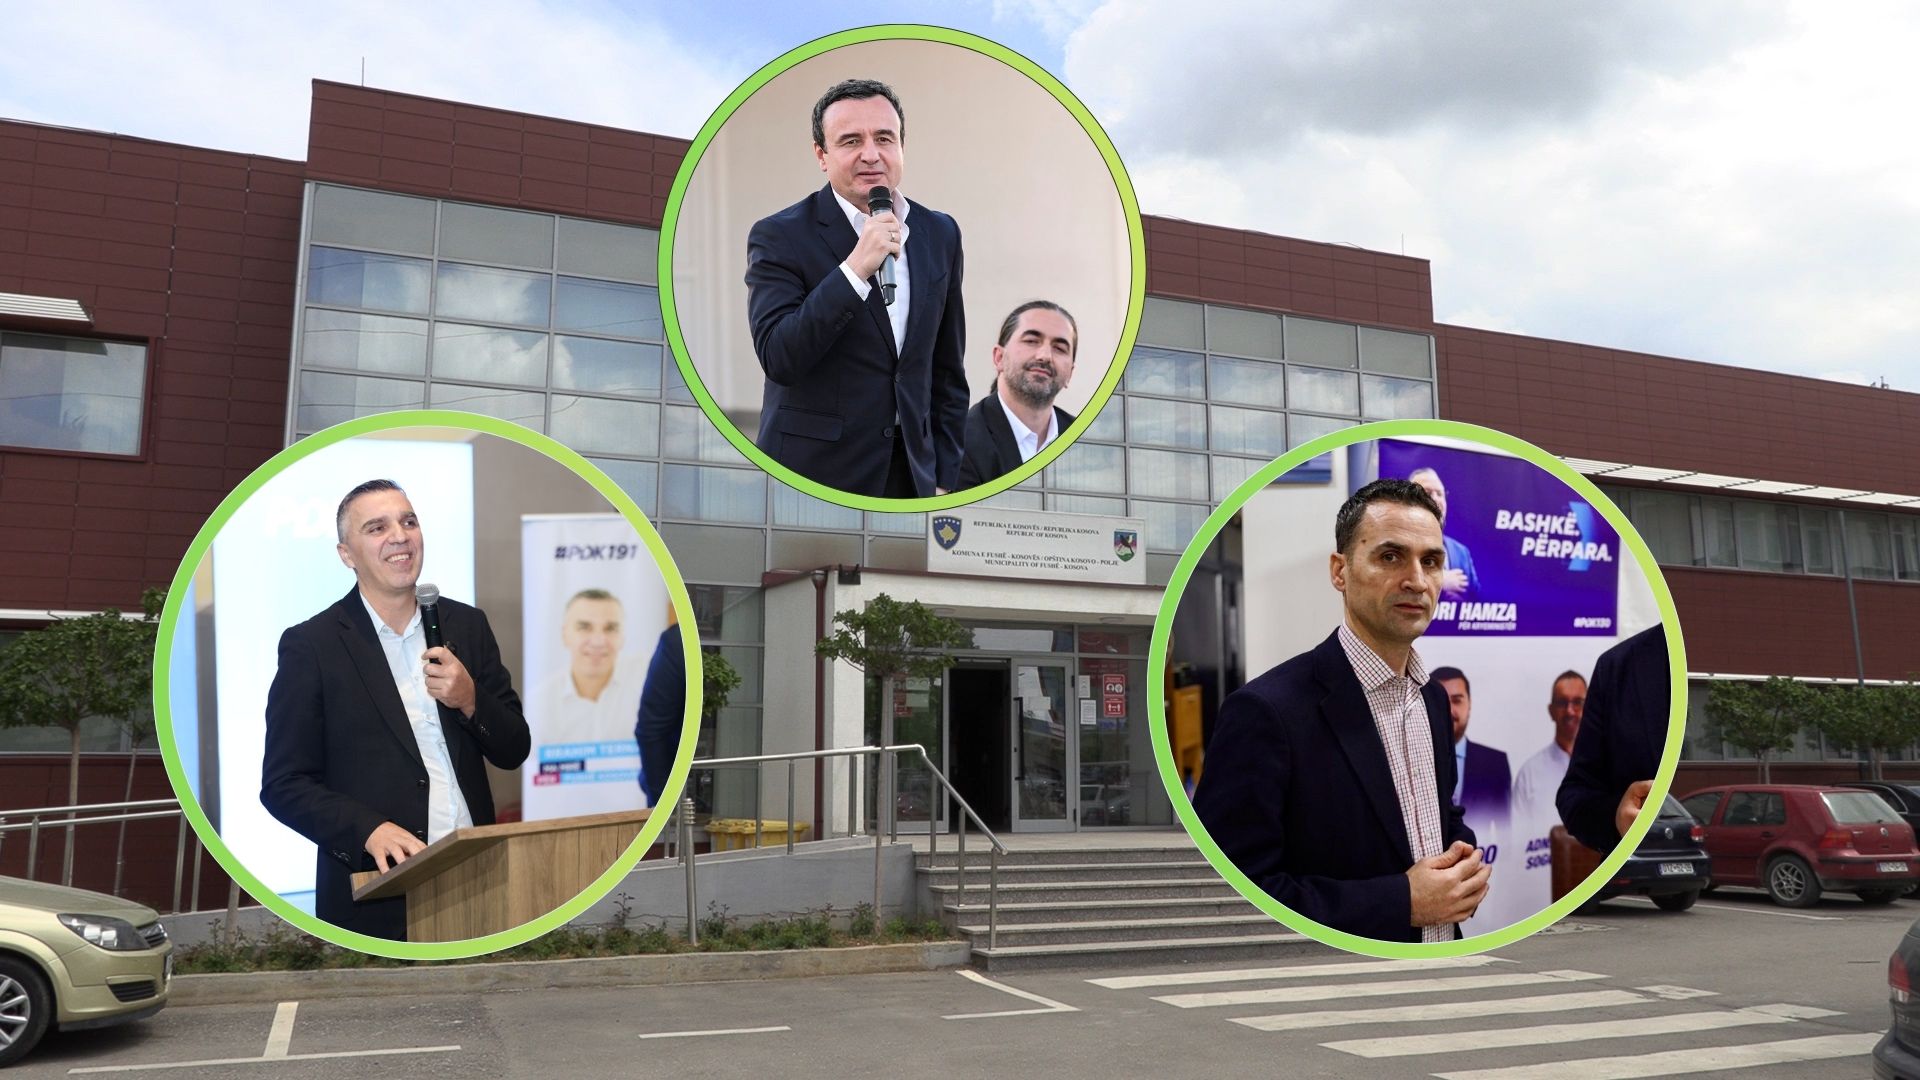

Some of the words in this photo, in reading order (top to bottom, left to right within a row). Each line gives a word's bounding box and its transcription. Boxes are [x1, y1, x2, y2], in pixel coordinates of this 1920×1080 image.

[973, 521, 1006, 529] REPUBLIKA
[1495, 510, 1580, 536] BASHKË.
[987, 551, 1007, 559] FUSHË
[1521, 534, 1612, 562] PËRPARA.
[985, 559, 1029, 567] MUNICIPALITY
[1040, 561, 1059, 569] FUSHË
[1459, 603, 1516, 621] HAMZA
